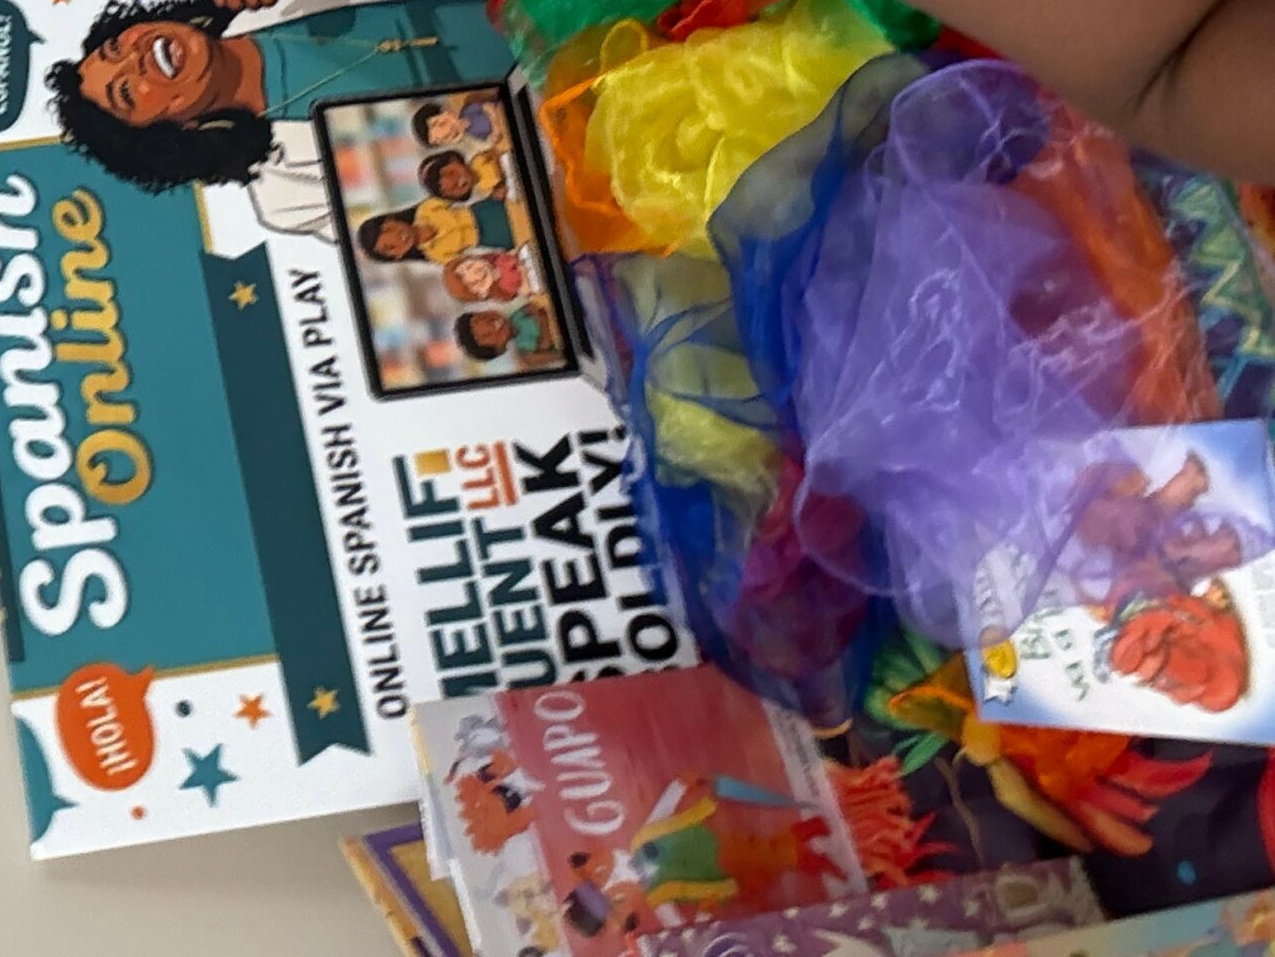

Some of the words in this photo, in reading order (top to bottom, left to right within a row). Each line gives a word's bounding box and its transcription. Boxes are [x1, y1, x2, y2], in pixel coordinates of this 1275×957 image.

[52, 187, 152, 505] Online
[290, 268, 332, 349] PLAY
[310, 358, 348, 416] VIA
[322, 419, 381, 578] SPANISH
[455, 441, 501, 512] LLC
[361, 582, 408, 720] ONLINE
[534, 690, 625, 836] GUAPO
